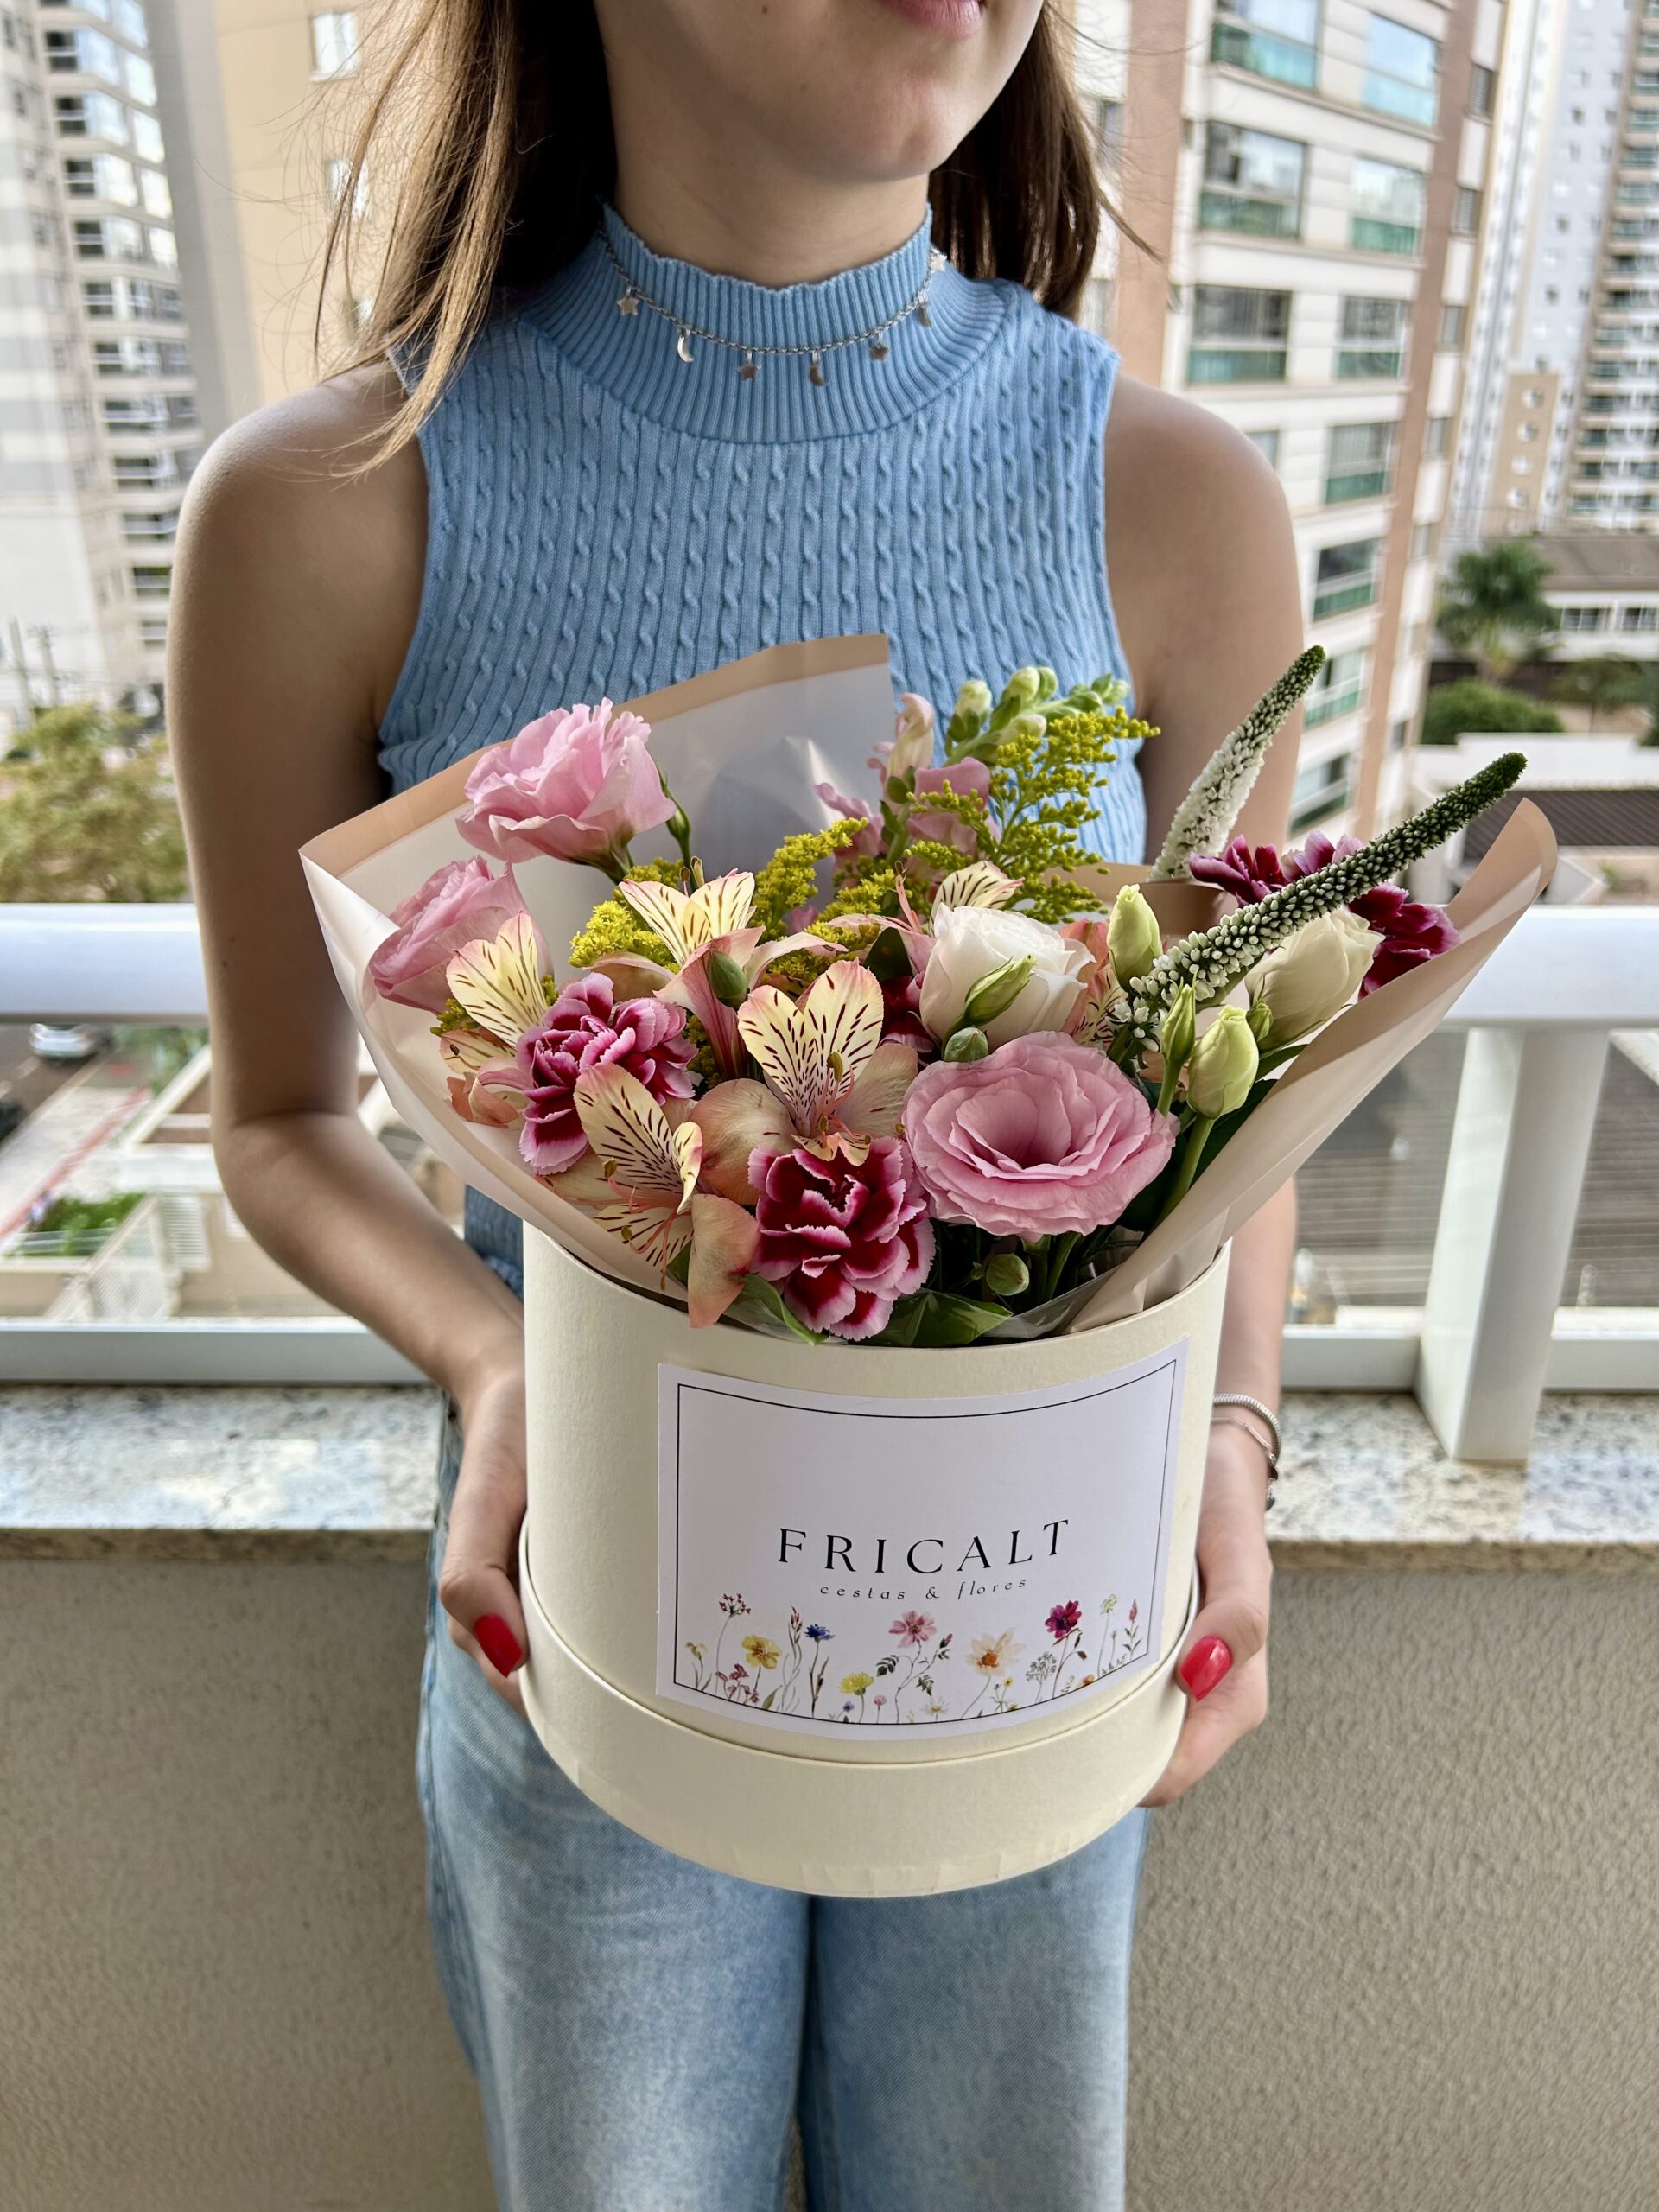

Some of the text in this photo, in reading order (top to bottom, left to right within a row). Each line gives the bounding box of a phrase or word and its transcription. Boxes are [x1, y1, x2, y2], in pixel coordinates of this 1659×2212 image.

[778, 1519, 1070, 1574] FRICALT
[819, 1579, 1027, 1600] cestas & flores
